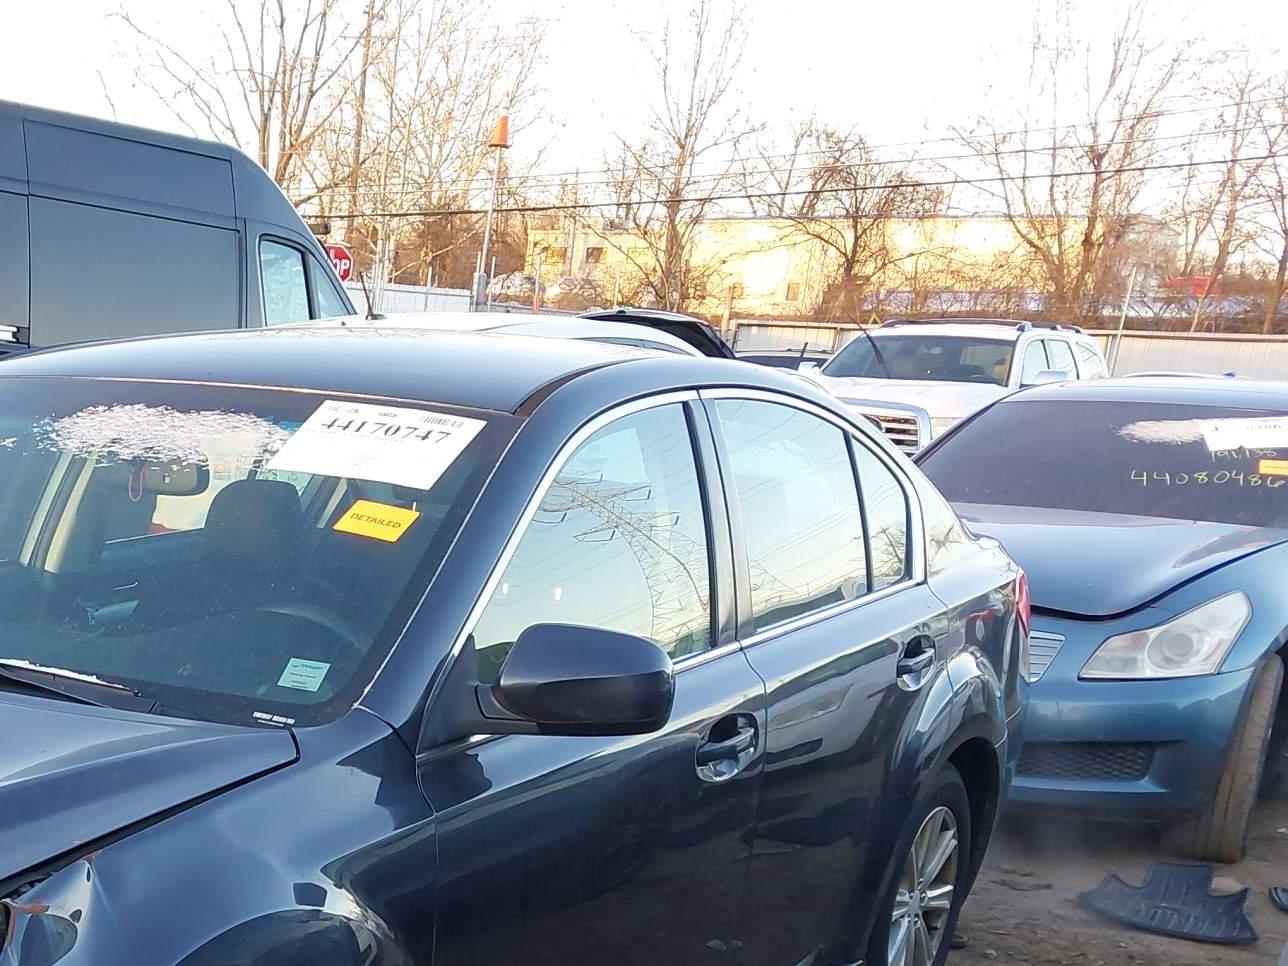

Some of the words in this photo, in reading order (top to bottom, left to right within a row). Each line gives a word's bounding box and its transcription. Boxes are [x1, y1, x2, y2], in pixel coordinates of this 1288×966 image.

[321, 417, 453, 444] 44170747
[1130, 469, 1287, 488] 44080486
[350, 513, 402, 529] DETAILED
